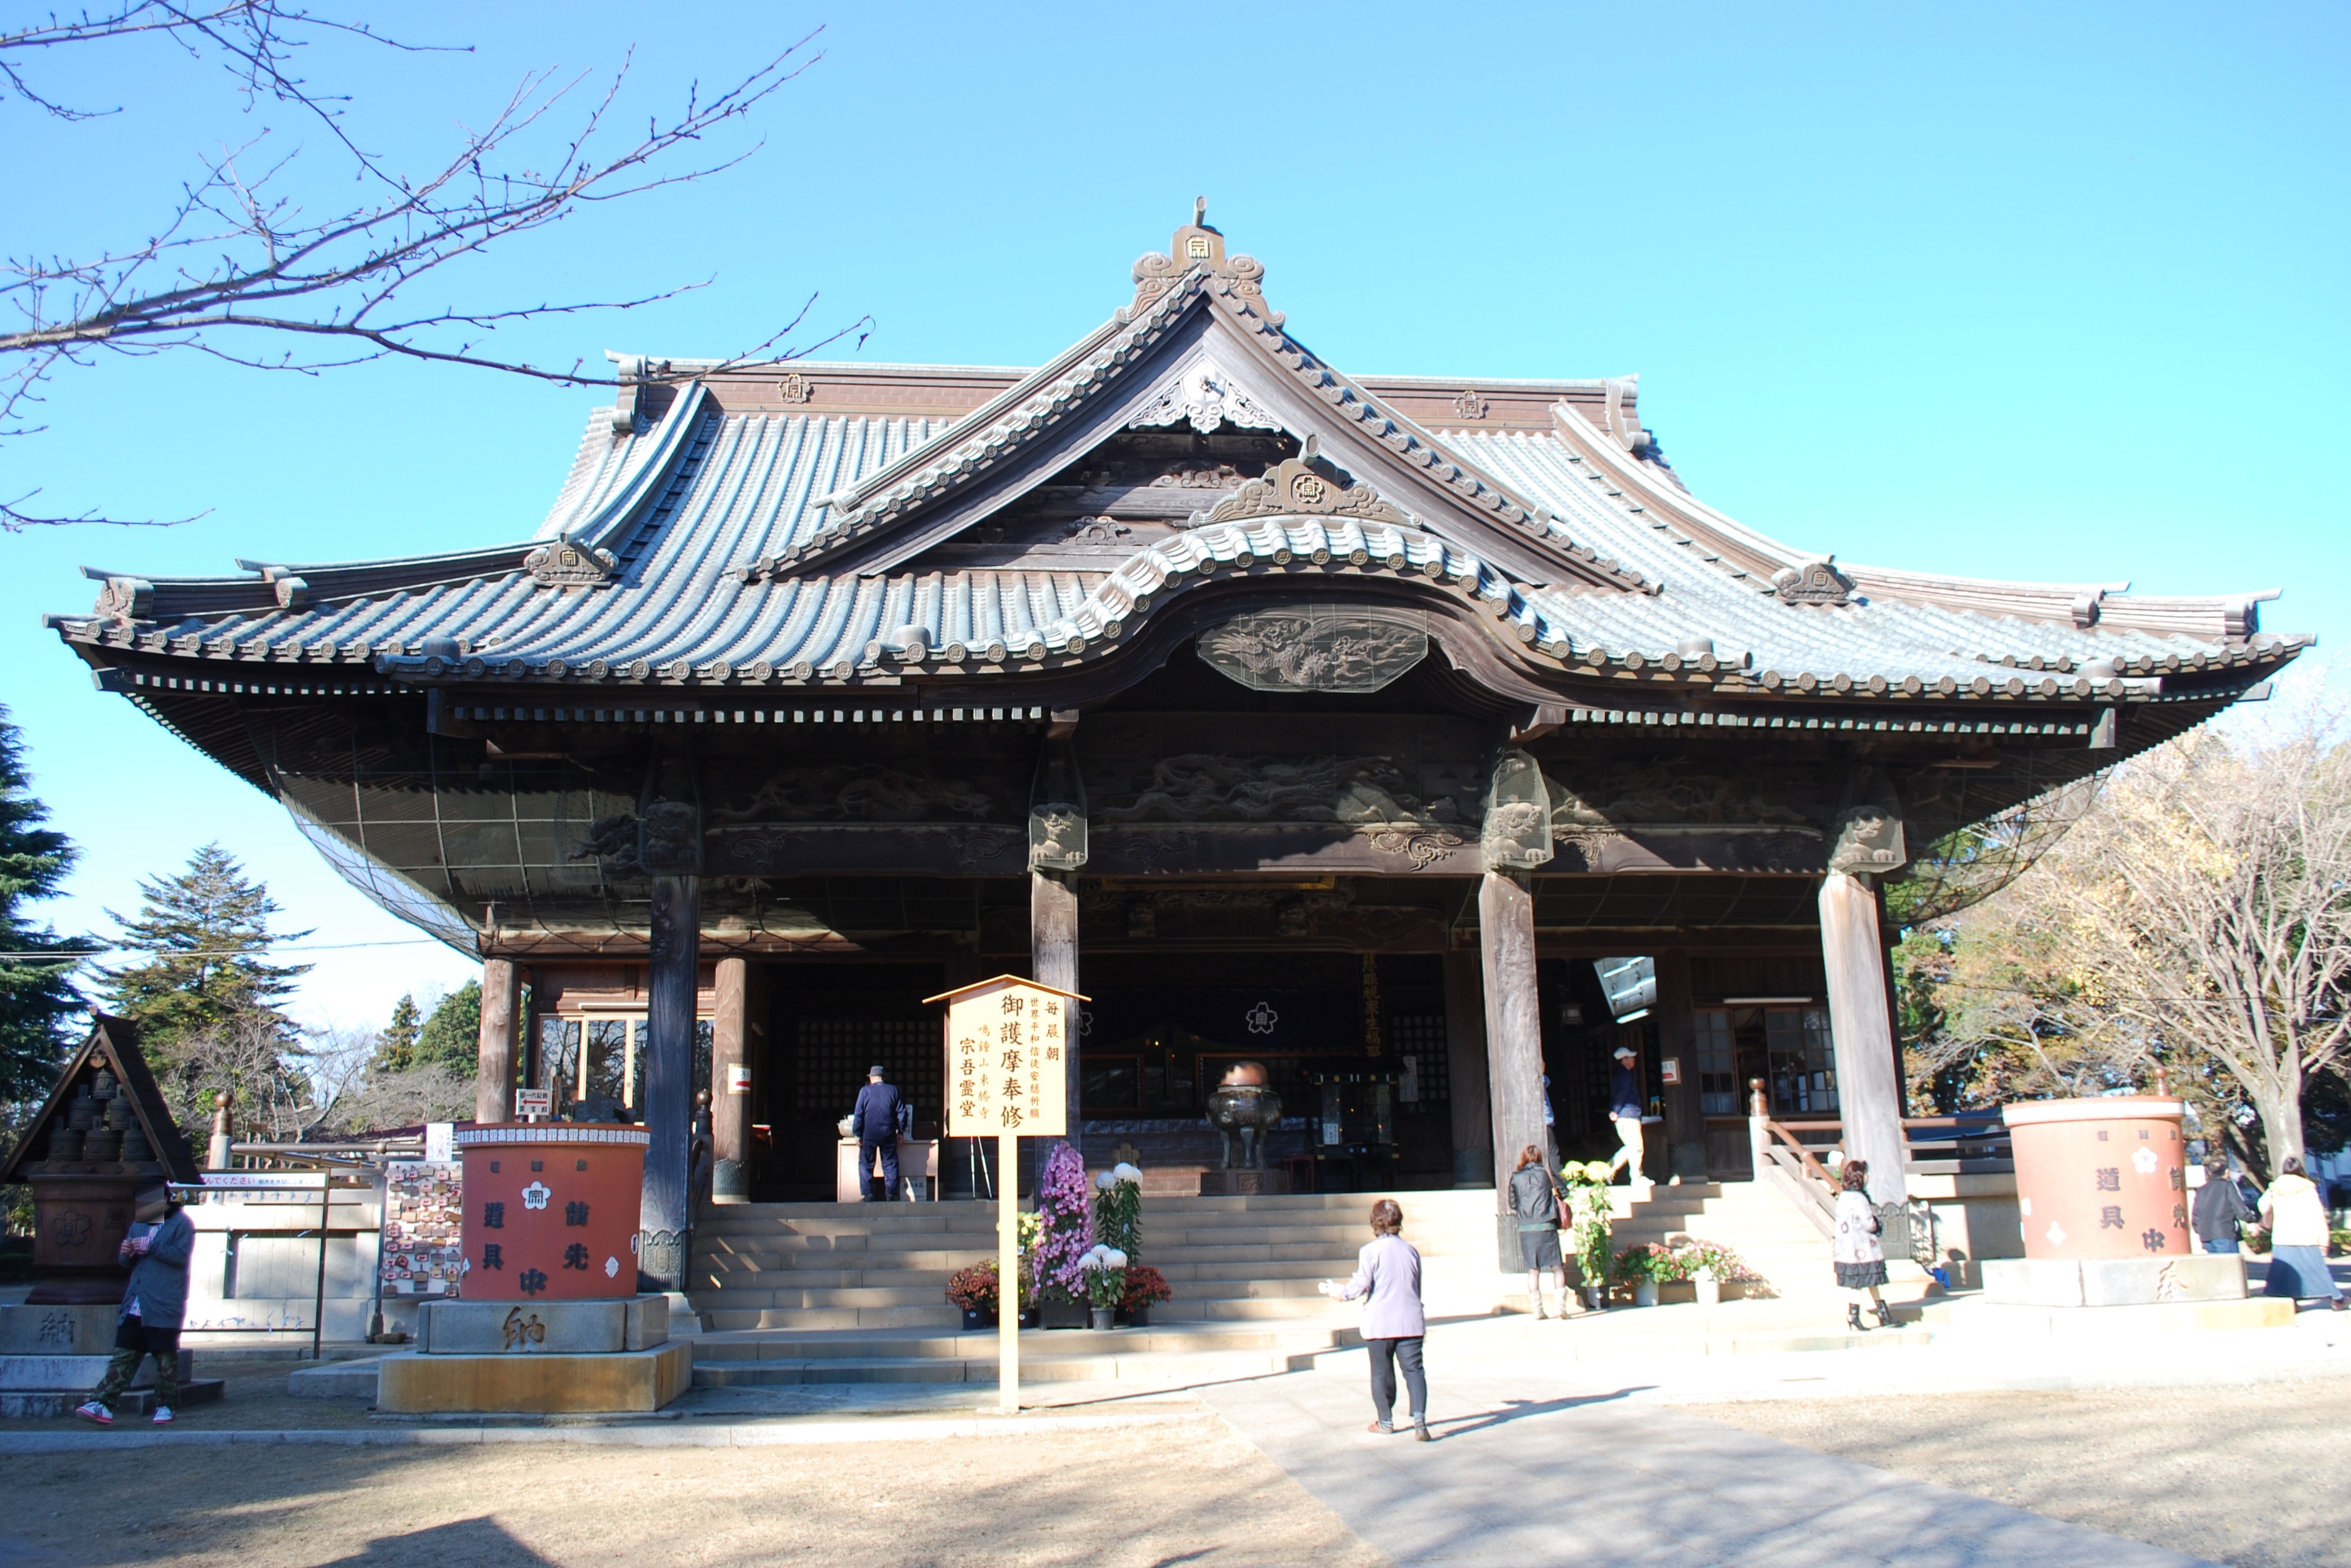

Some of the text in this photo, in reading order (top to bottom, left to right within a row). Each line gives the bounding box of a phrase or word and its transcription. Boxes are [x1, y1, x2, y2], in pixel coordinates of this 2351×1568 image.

[1000, 994, 1024, 1129] 御護摩奉修
[1044, 1001, 1060, 1061] 毎晨朝
[960, 1038, 976, 1117] 宗吾霊堂
[978, 1024, 991, 1119] 鳴鐘山東勝寺
[199, 1176, 255, 1186] んでください
[2096, 1167, 2125, 1229] 道具
[483, 1201, 505, 1271] 道具
[2142, 1228, 2165, 1253] 中
[38, 1312, 76, 1344] 納
[503, 1306, 546, 1350] 納
